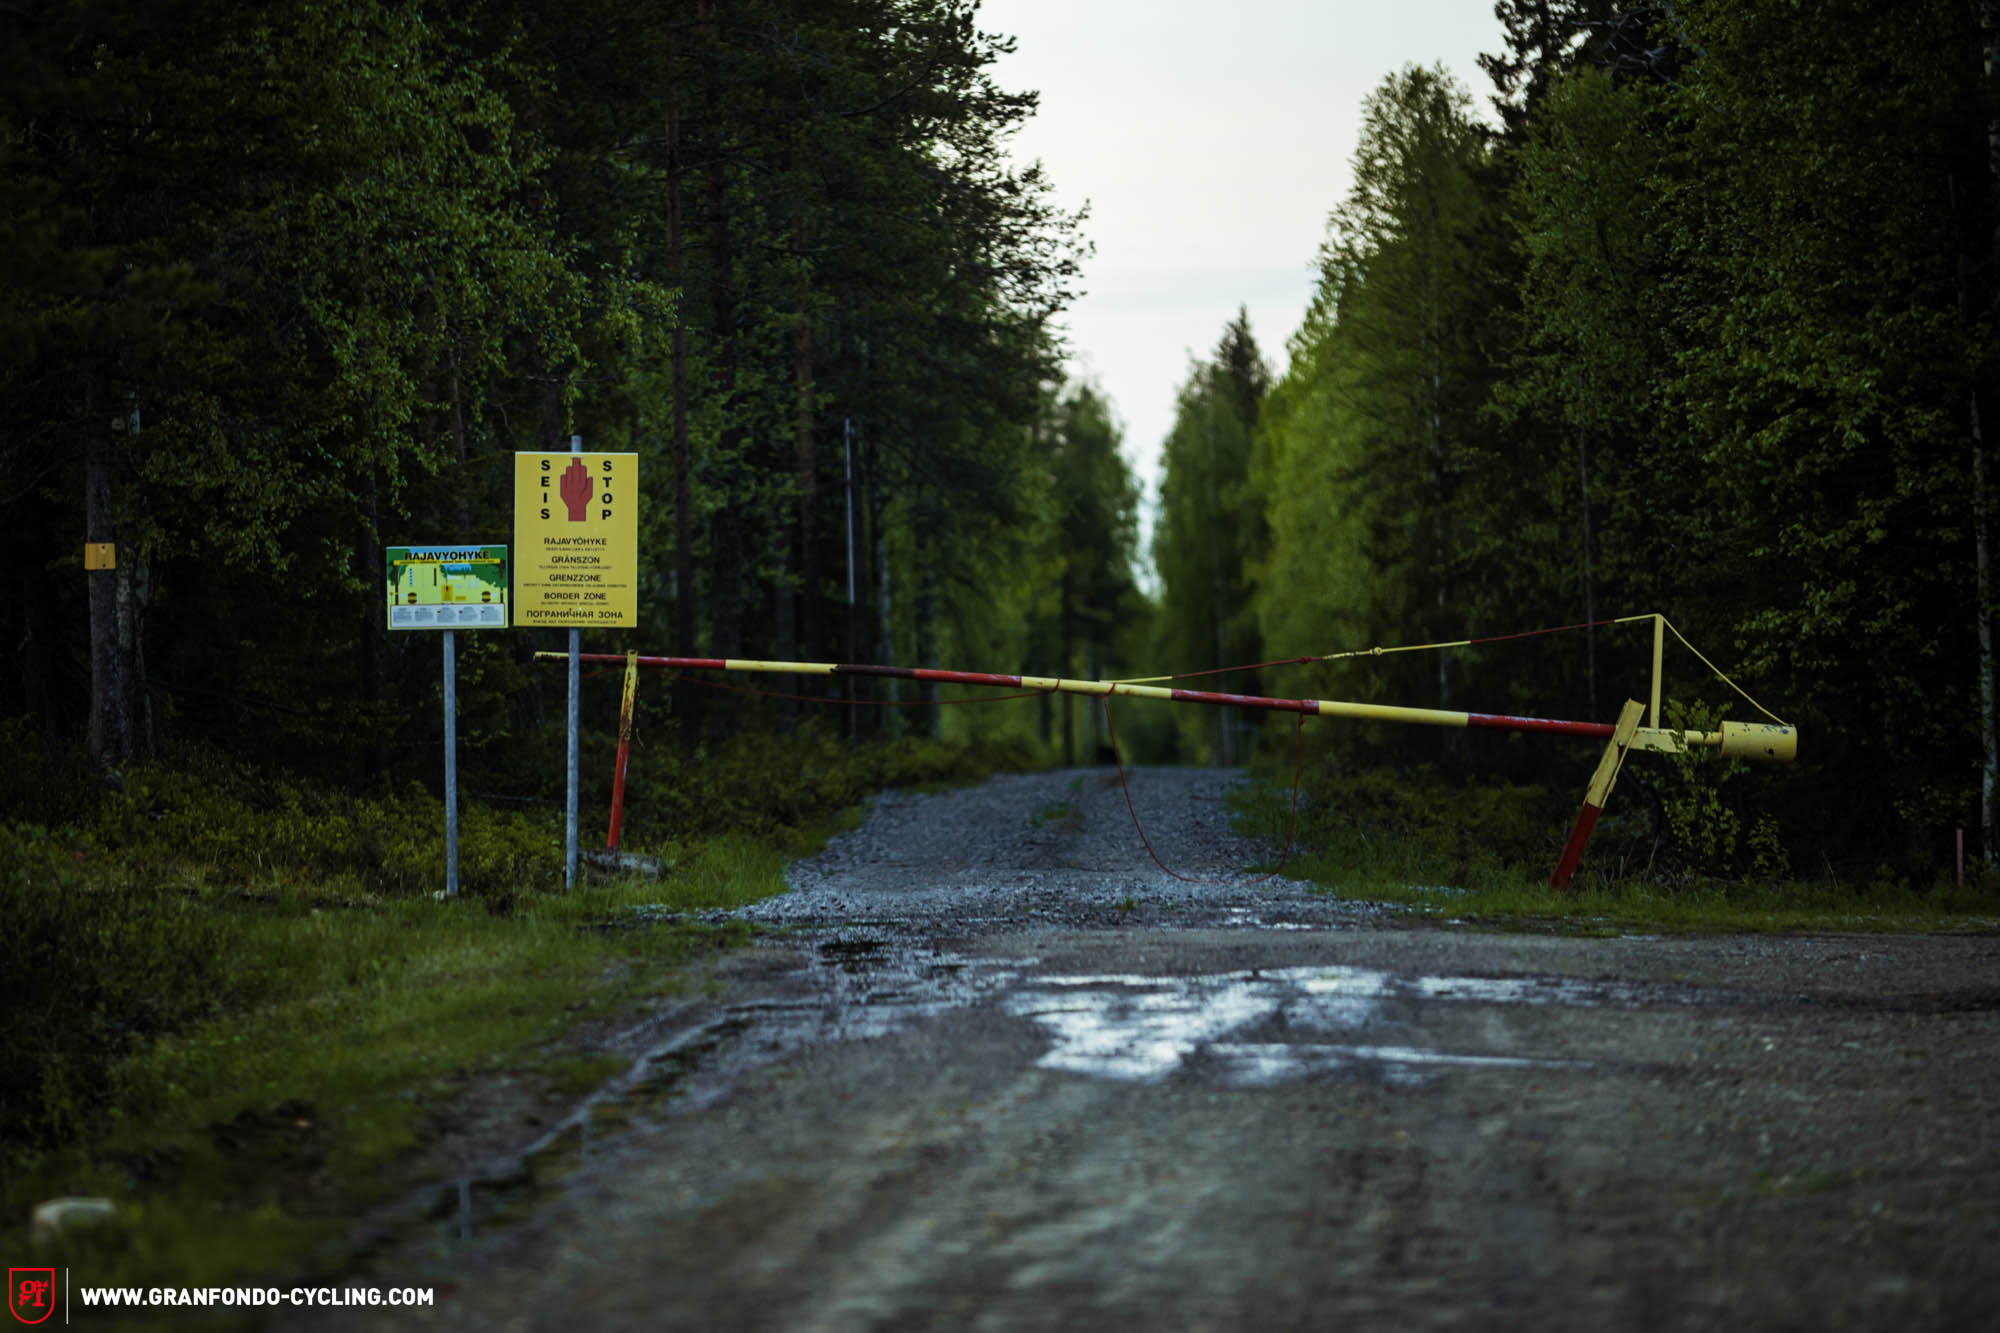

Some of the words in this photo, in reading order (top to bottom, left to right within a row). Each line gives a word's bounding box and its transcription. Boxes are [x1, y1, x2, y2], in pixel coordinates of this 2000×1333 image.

[541, 460, 550, 520] SEIS
[602, 460, 613, 520] STOP
[549, 574, 601, 582] GRENZZONE
[544, 592, 580, 600] BORDER
[583, 592, 606, 601] ZONE
[526, 609, 594, 619] ПОГРАНИЧНАЯ
[598, 610, 623, 619] ЗОНА
